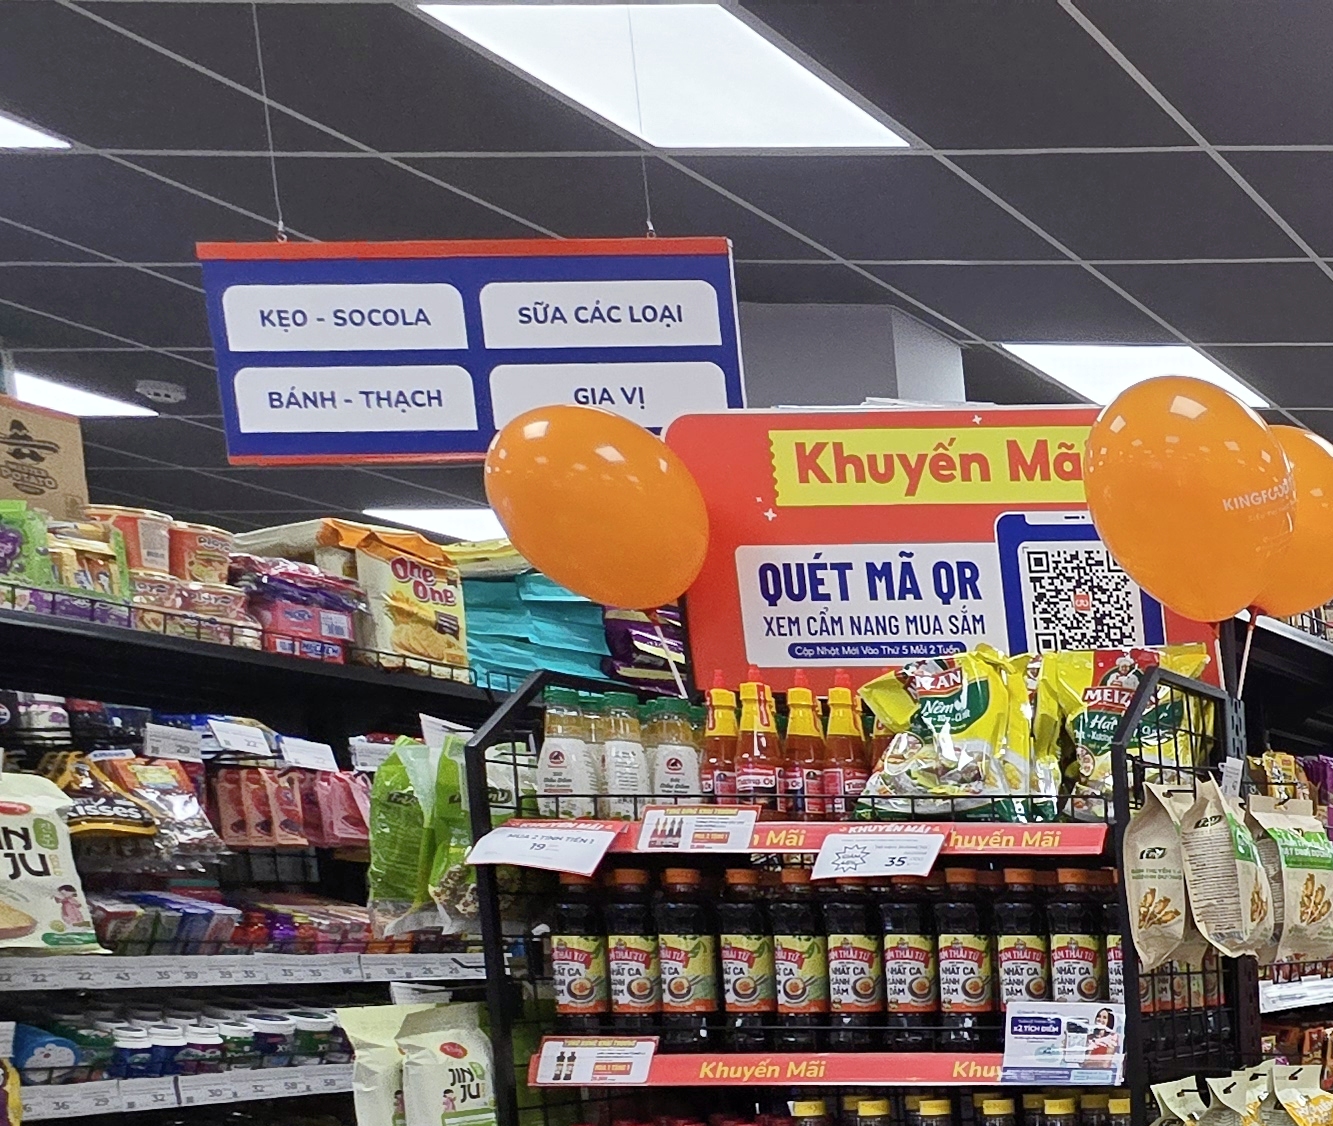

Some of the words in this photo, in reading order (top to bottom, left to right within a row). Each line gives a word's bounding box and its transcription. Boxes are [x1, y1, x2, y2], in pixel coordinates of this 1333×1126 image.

[260, 310, 307, 332] KẸO
[333, 309, 430, 327] SOCOLA
[518, 299, 567, 325] SỮA
[573, 299, 621, 324] CÁC
[629, 304, 683, 330] LOẠI
[268, 383, 337, 410] BÁNH
[359, 389, 443, 415] THẠCH
[573, 387, 616, 406] GIA
[620, 386, 644, 410] VỊ
[795, 432, 992, 497] Khuyến
[1008, 440, 1086, 482] Mã
[391, 557, 436, 586] One
[758, 552, 854, 607] QUÉT
[866, 551, 923, 601] MÃ
[932, 561, 982, 605] QR
[413, 580, 456, 606] One
[763, 615, 801, 637] XEM
[807, 606, 844, 637] CẨM
[850, 615, 900, 636] NANG
[906, 614, 944, 636] MUA
[950, 605, 986, 636] SẮM
[902, 646, 909, 655] 5
[929, 645, 936, 655] 2
[1084, 689, 1133, 707] MEIZ
[529, 842, 546, 852] 19
[767, 829, 804, 847] Mãi
[950, 828, 1015, 850] huyến
[1021, 829, 1062, 848] Mãi
[884, 856, 906, 867] 35
[449, 1068, 474, 1087] JIN
[700, 1058, 780, 1081] Khuyến
[784, 1057, 826, 1078] Mãi
[952, 1059, 1004, 1081] Khuy
[460, 1083, 481, 1103] JU
